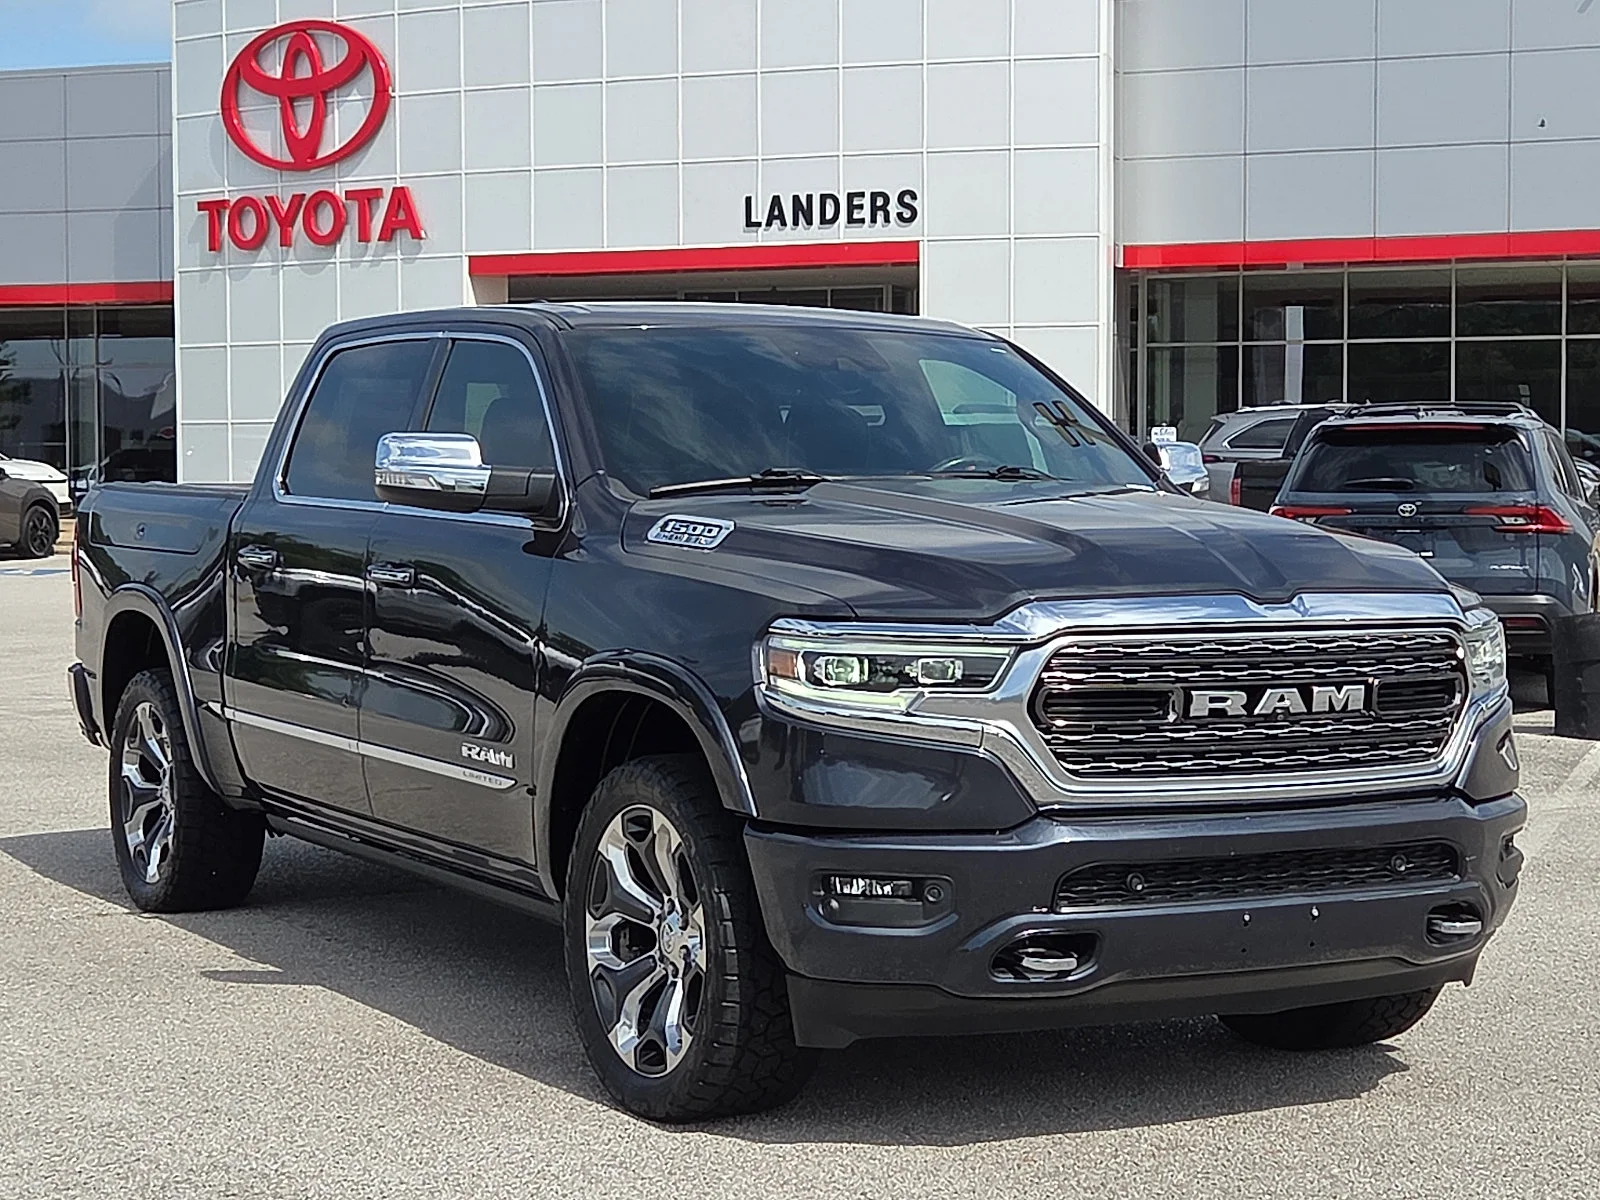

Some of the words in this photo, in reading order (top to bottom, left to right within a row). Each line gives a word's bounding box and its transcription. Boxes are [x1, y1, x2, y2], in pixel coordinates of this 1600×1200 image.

[197, 186, 426, 252] TOYOTA
[744, 189, 918, 229] LANDERS
[664, 520, 721, 538] 1500
[1189, 685, 1365, 717] RAM
[461, 742, 514, 769] RAM
